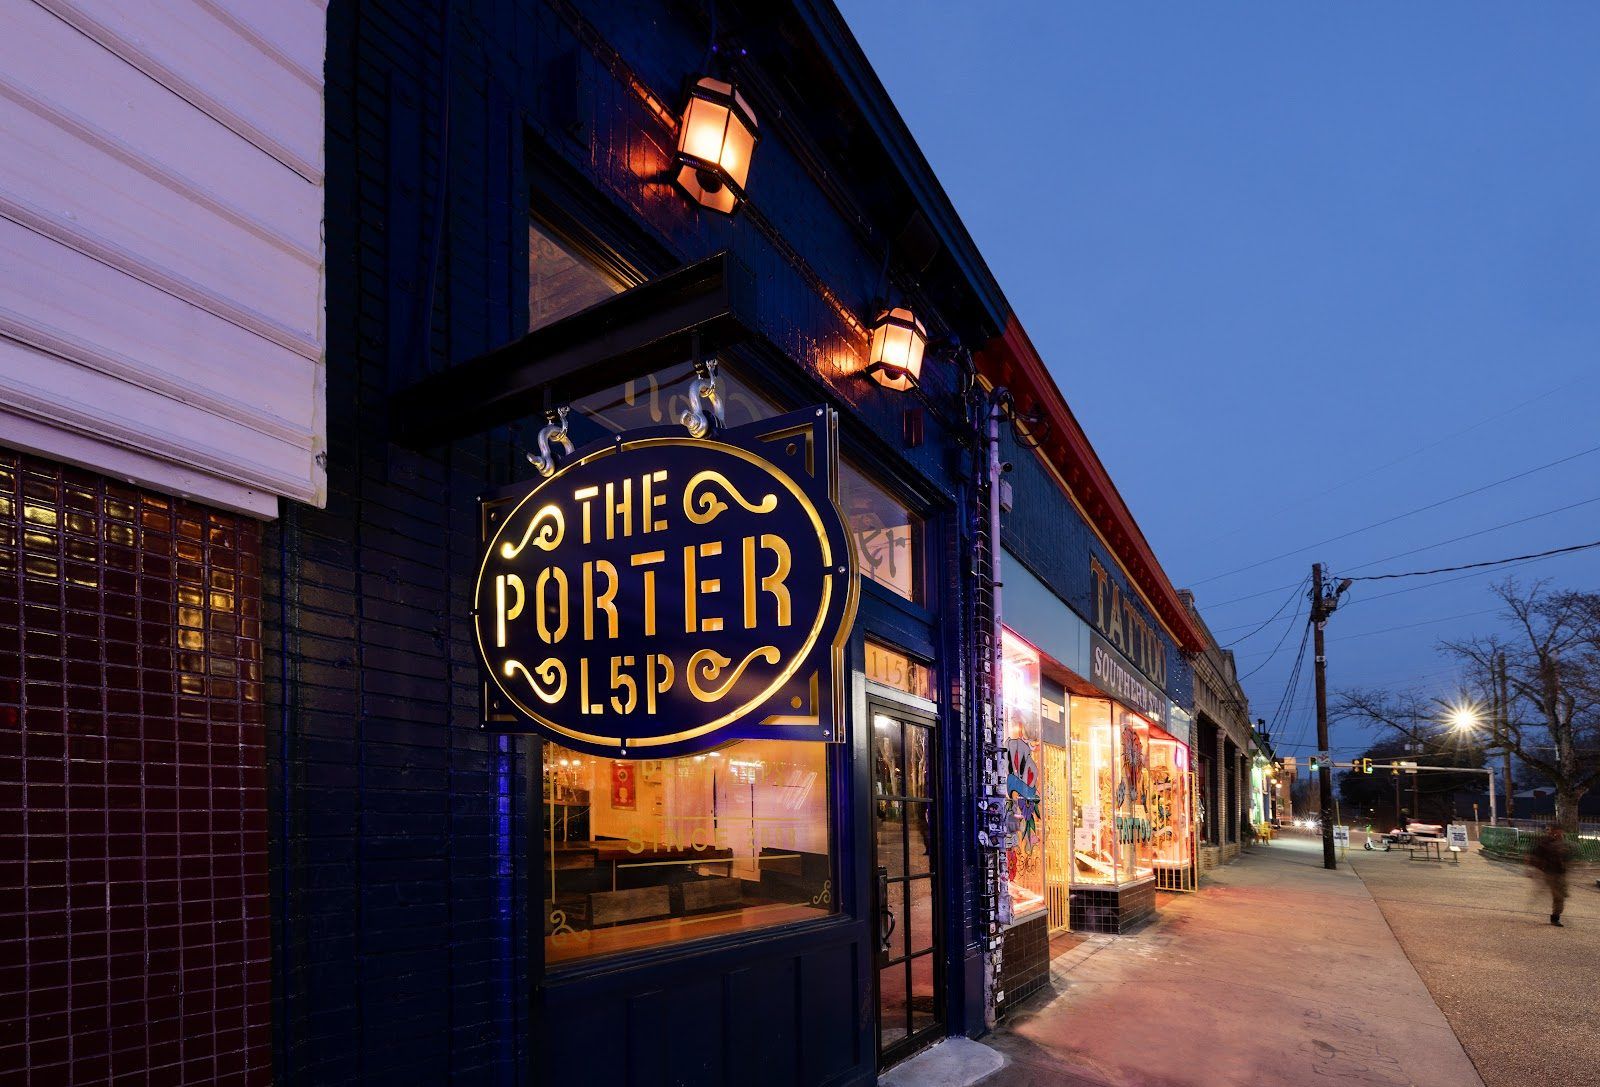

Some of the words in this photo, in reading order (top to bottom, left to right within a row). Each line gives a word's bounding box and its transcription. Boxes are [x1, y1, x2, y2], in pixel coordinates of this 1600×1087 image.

[574, 469, 670, 544] THE
[496, 533, 792, 648] PORTER
[1091, 557, 1167, 690] TATTOO
[580, 653, 675, 715] L5P
[1094, 646, 1148, 711] SOUTHERN
[626, 827, 729, 854] SINCE
[1116, 816, 1152, 845] TATTOO
